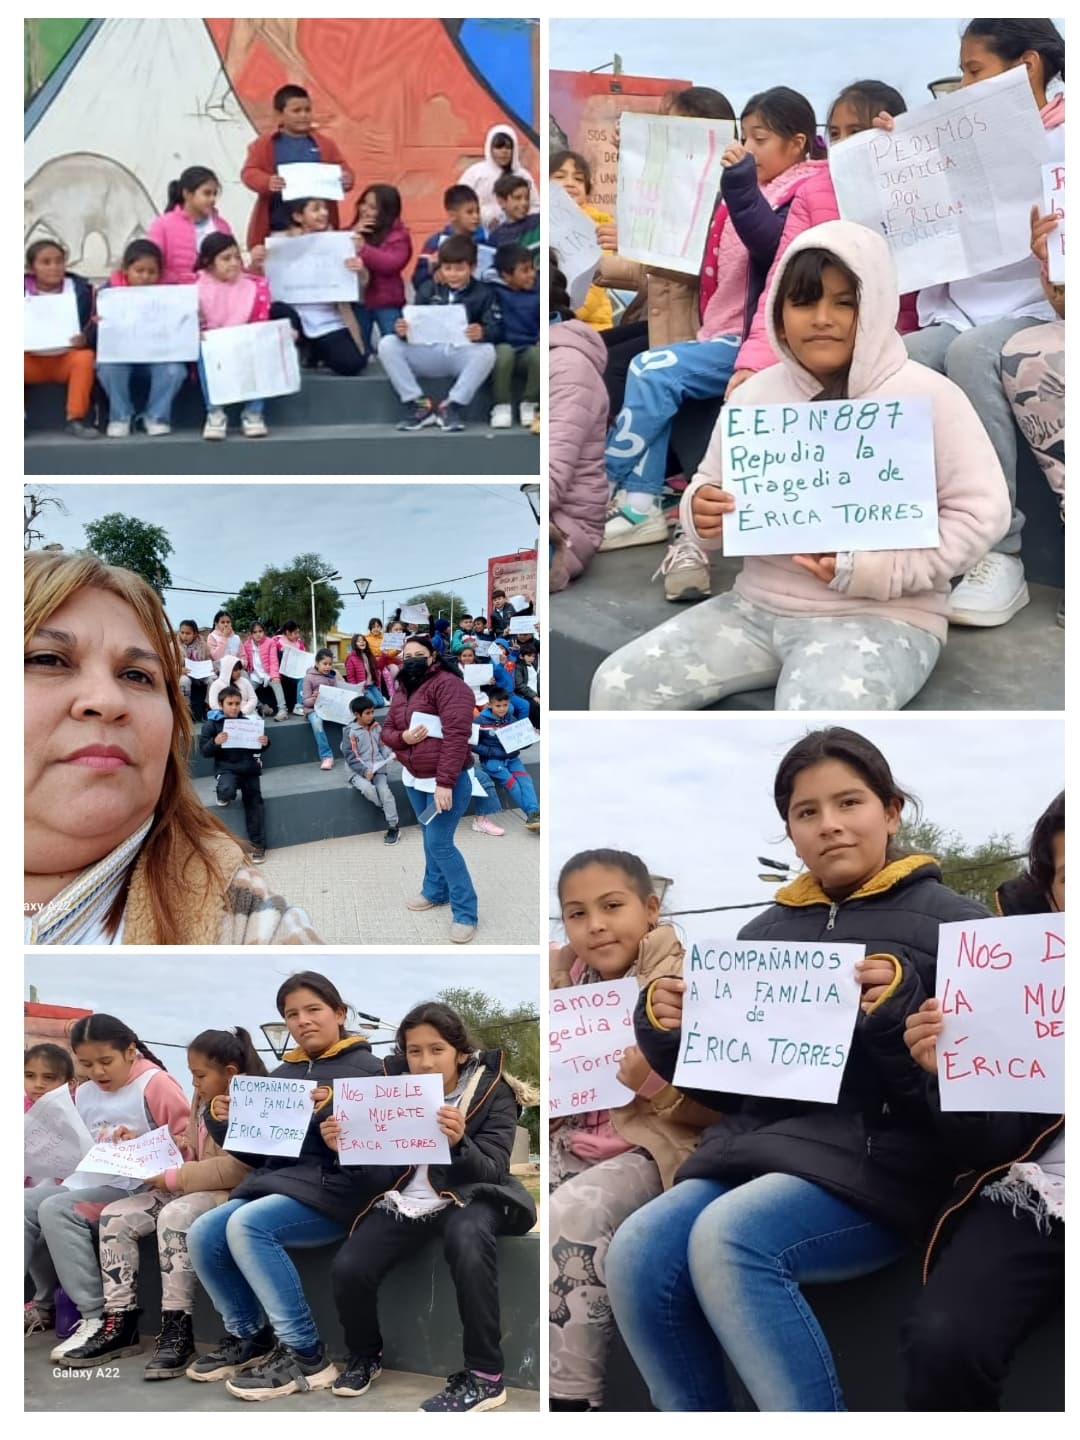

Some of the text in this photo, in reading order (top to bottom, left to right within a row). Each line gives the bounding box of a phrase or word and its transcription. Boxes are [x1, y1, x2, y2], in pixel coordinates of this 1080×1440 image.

[869, 112, 987, 169] PEDIMOS
[880, 155, 957, 190] JUSTICIA
[833, 401, 904, 432] 887
[730, 435, 874, 477] Repudia la
[732, 459, 904, 502] Tragedia de
[738, 503, 924, 532] ÉRICA TORRES
[691, 943, 841, 972] ACOMPAÑAMOS
[957, 931, 1012, 970] NOS
[690, 978, 840, 1004] A LA FAMILIA
[941, 978, 973, 1015] LA
[746, 1005, 765, 1023] de
[1035, 1020, 1065, 1039] DE
[683, 1021, 845, 1067] ÉRICA TORRES
[562, 1047, 622, 1074] Torre
[943, 1036, 1046, 1080] ÉRICA
[232, 1077, 306, 1093] ACOMPAÑAMOS
[375, 1083, 423, 1098] DUELE
[571, 1088, 598, 1108] 887
[232, 1096, 305, 1110] A LA FAMILIA
[260, 1110, 269, 1119] de
[334, 1105, 425, 1122] LA MUERTE
[228, 1117, 305, 1141] ÉRICA TORRES
[338, 1130, 438, 1151] ÉRICA TORRES
[375, 1123, 388, 1133] DE
